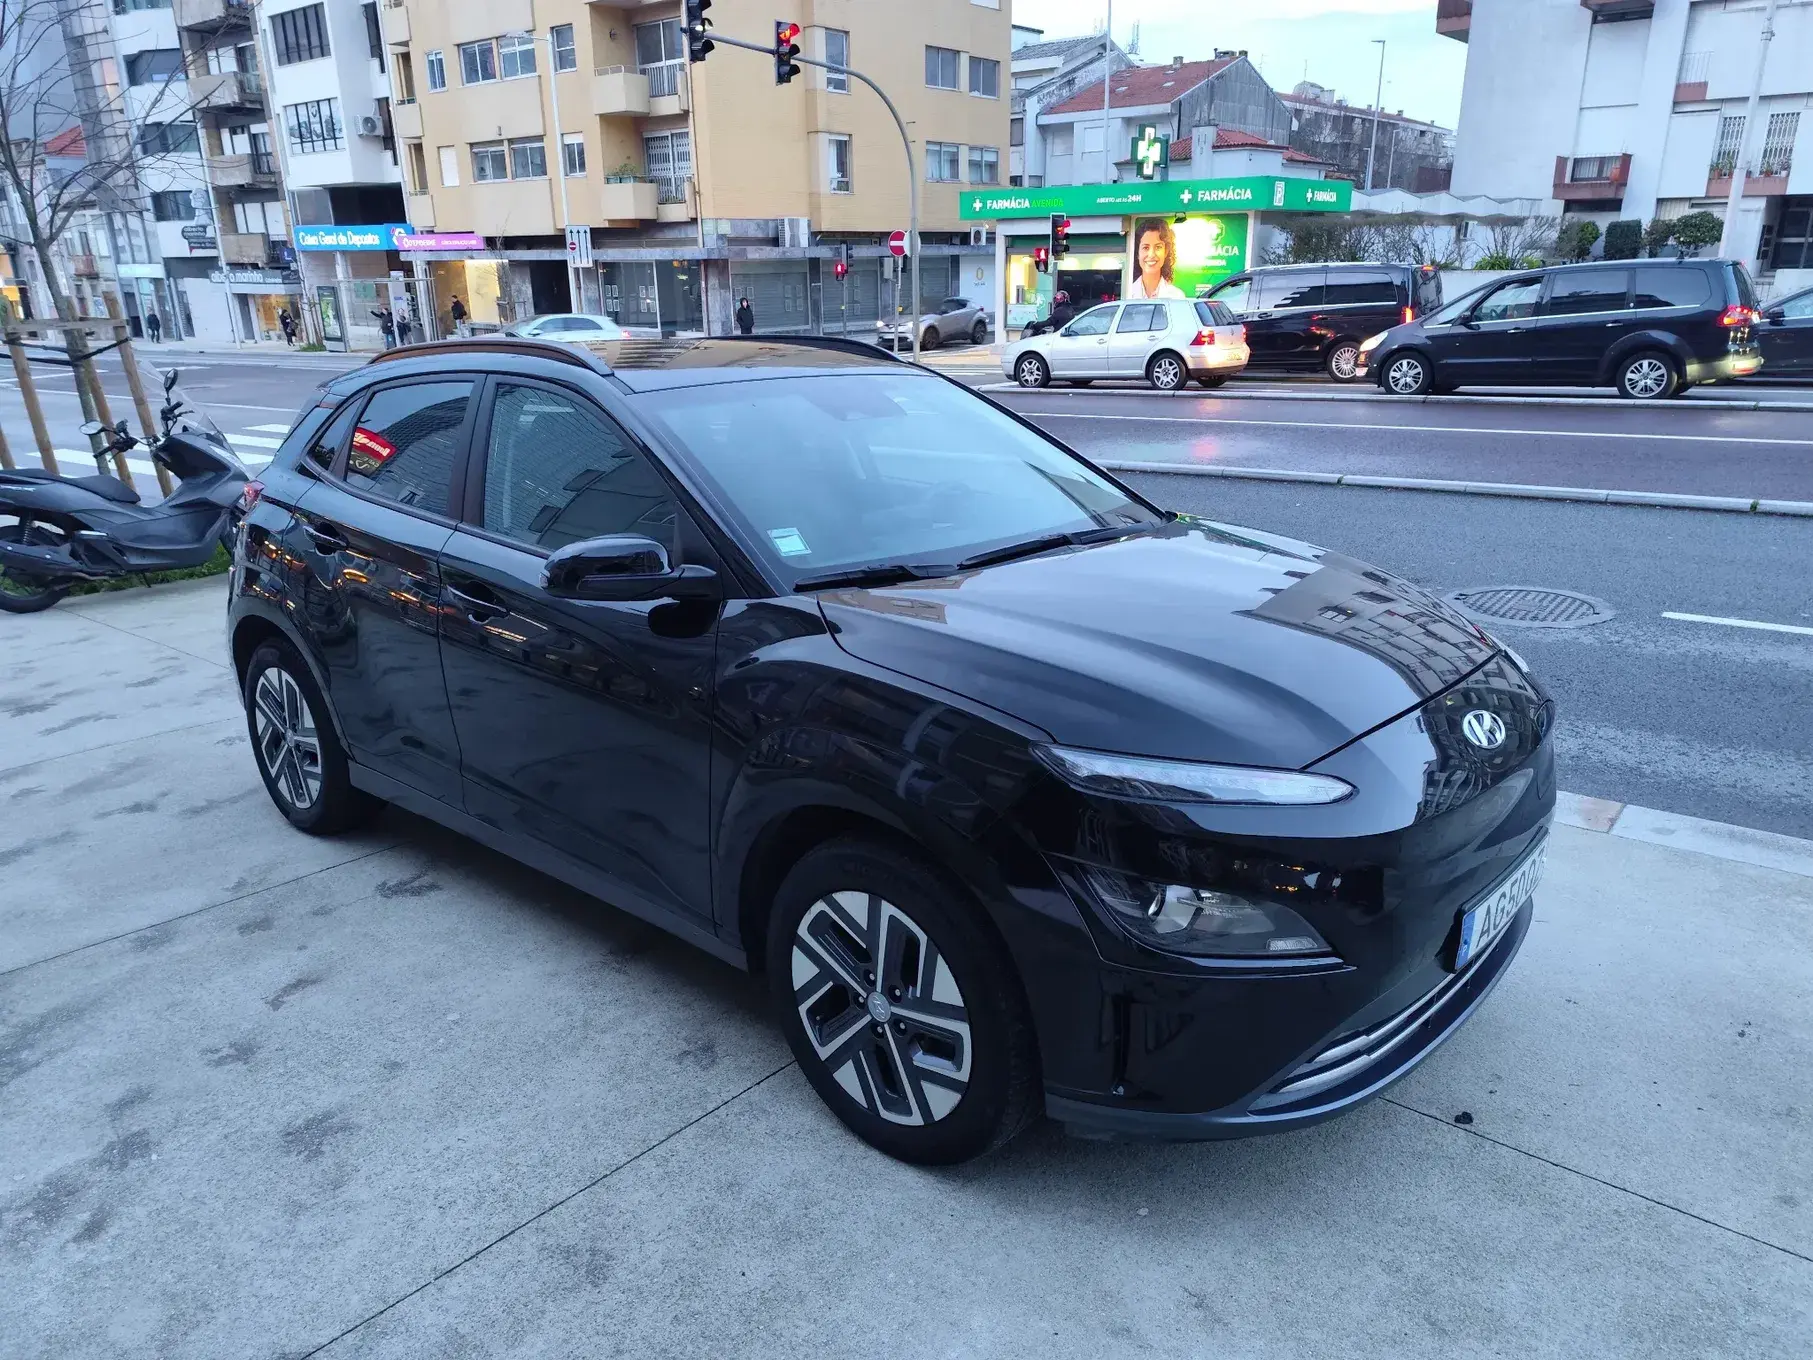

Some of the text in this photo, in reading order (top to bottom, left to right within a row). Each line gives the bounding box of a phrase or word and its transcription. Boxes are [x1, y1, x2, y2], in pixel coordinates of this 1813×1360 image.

[1127, 194, 1142, 203] 24H
[1197, 186, 1252, 202] FARMÁCIA
[1313, 188, 1337, 202] FARMÁCIA
[986, 196, 1064, 210] FARMÁCIA AVENIDA
[319, 231, 337, 245] Geral
[337, 232, 347, 245] de
[235, 270, 264, 282] marinho
